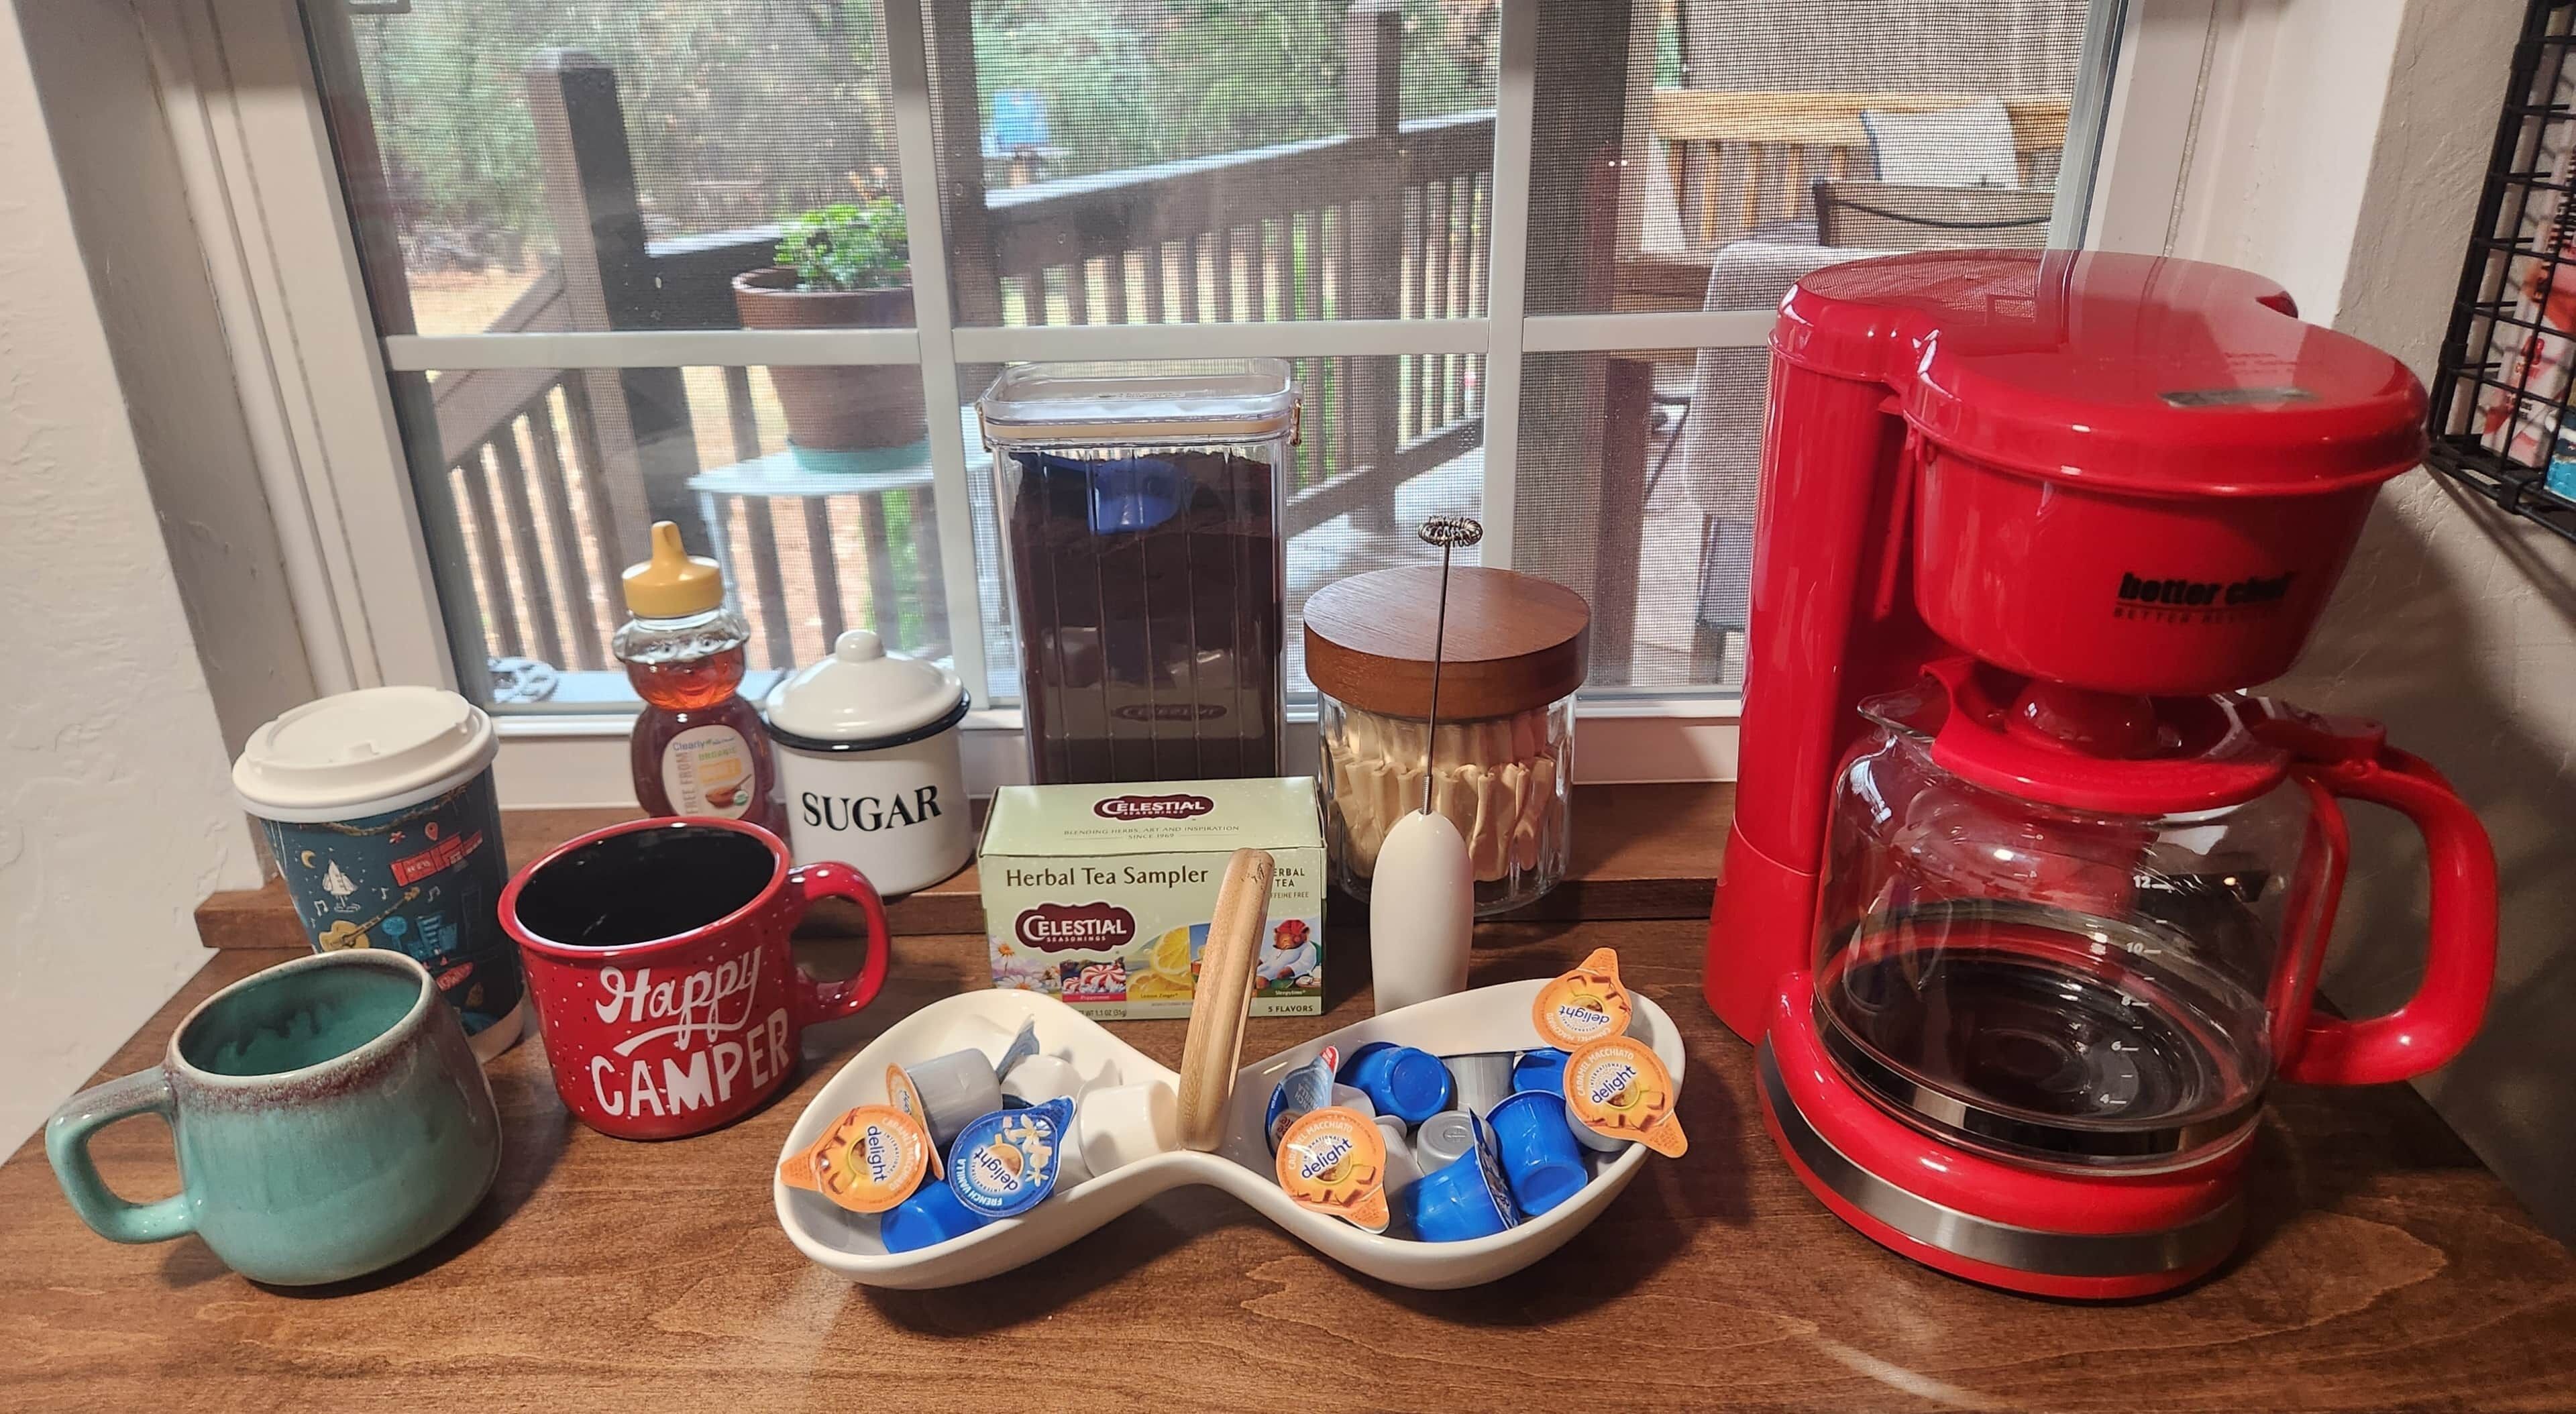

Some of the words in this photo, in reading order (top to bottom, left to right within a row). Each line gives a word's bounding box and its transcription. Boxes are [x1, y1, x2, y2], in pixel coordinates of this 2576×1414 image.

[673, 740, 704, 751] Clearly
[802, 785, 942, 832] SUGAR
[1102, 800, 1205, 815] CELESTIAL
[1006, 867, 1075, 887] Herbal
[1081, 867, 1116, 885] Tea
[1123, 865, 1209, 888] Sampler
[1274, 867, 1305, 877] ERBAL
[1275, 879, 1295, 887] TEA
[2133, 875, 2151, 889] 12
[1022, 915, 1127, 941] CELESTIAL
[2126, 942, 2144, 954] 10
[596, 946, 762, 1053] Happy
[2121, 995, 2131, 1006] 8
[1558, 1005, 1610, 1025] delight
[2111, 1040, 2121, 1051] 6
[591, 1008, 790, 1117] CAMPER
[1576, 1060, 1591, 1097] CARAMEL
[1588, 1048, 1635, 1061] MACCHIATO
[1590, 1062, 1623, 1088] INTERNATIONAL
[1591, 1065, 1636, 1103] delight
[2100, 1093, 2110, 1104] 4
[1306, 1120, 1353, 1136] MACCHIATO
[867, 1126, 888, 1183] delight
[883, 1132, 901, 1175] INTERNATIONAL
[1301, 1138, 1353, 1179] delight
[956, 1158, 972, 1193] VANILLA
[971, 1162, 1001, 1192] INTERNATIONAL
[973, 1147, 1018, 1191] delight
[969, 1187, 1003, 1207] FRENCH
